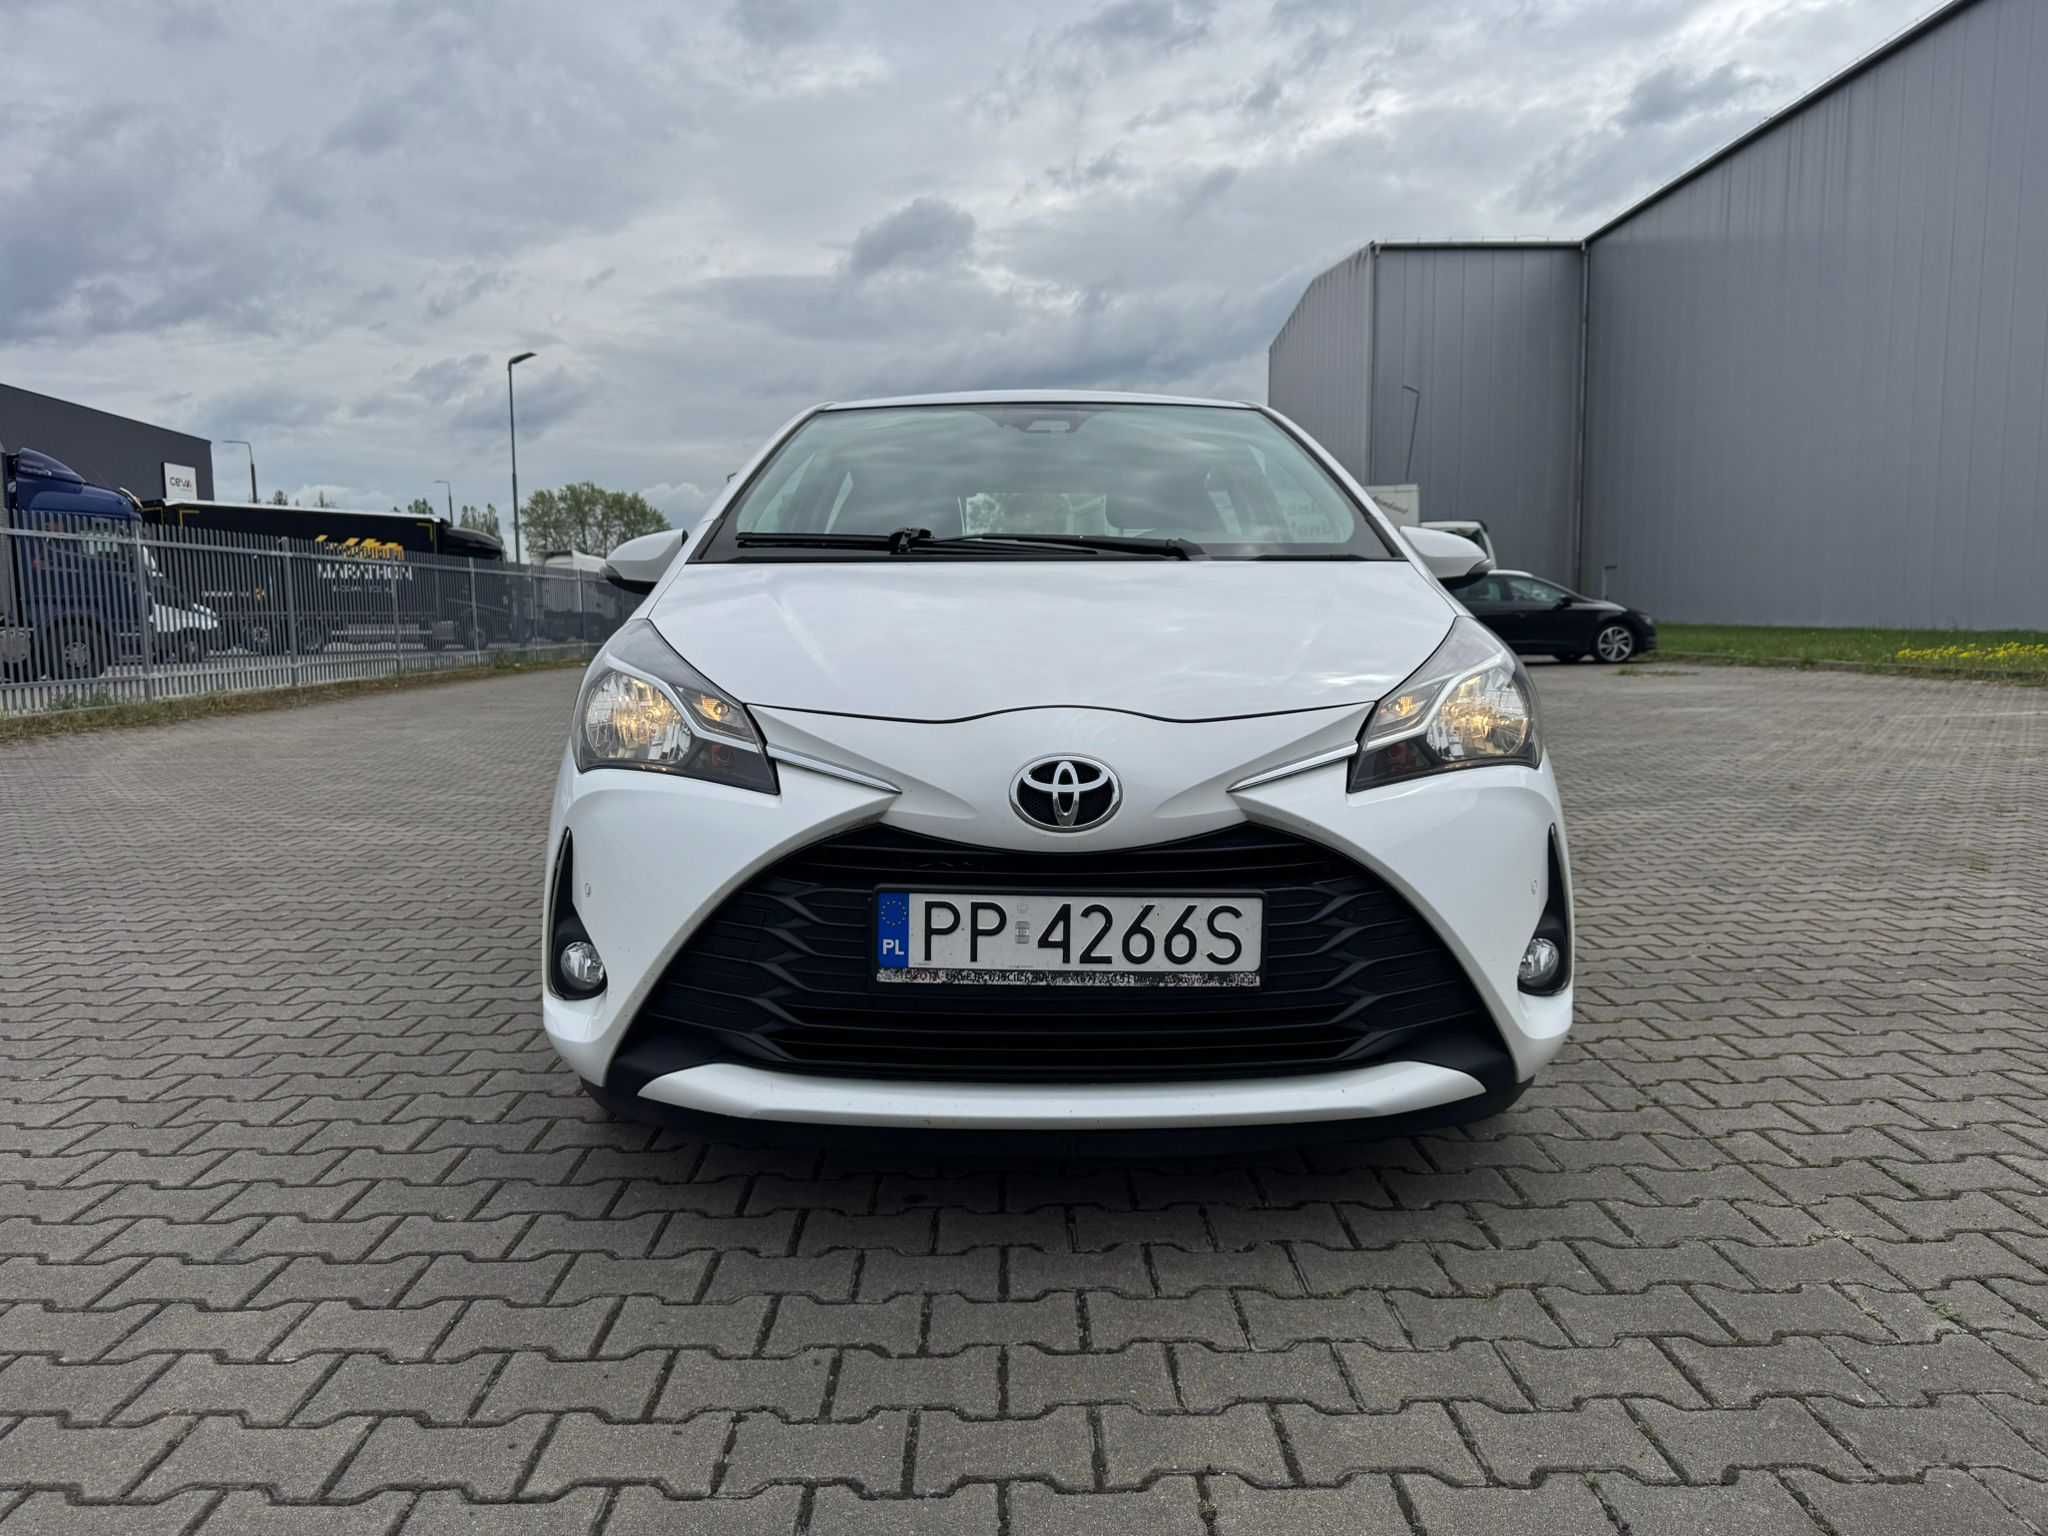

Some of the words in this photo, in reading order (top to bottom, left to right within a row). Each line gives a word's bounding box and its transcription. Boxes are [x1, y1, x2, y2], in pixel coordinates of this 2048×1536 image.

[317, 563, 413, 581] MARATHON
[924, 900, 1008, 963] PP
[1037, 903, 1243, 965] 4266S
[882, 938, 905, 955] PL
